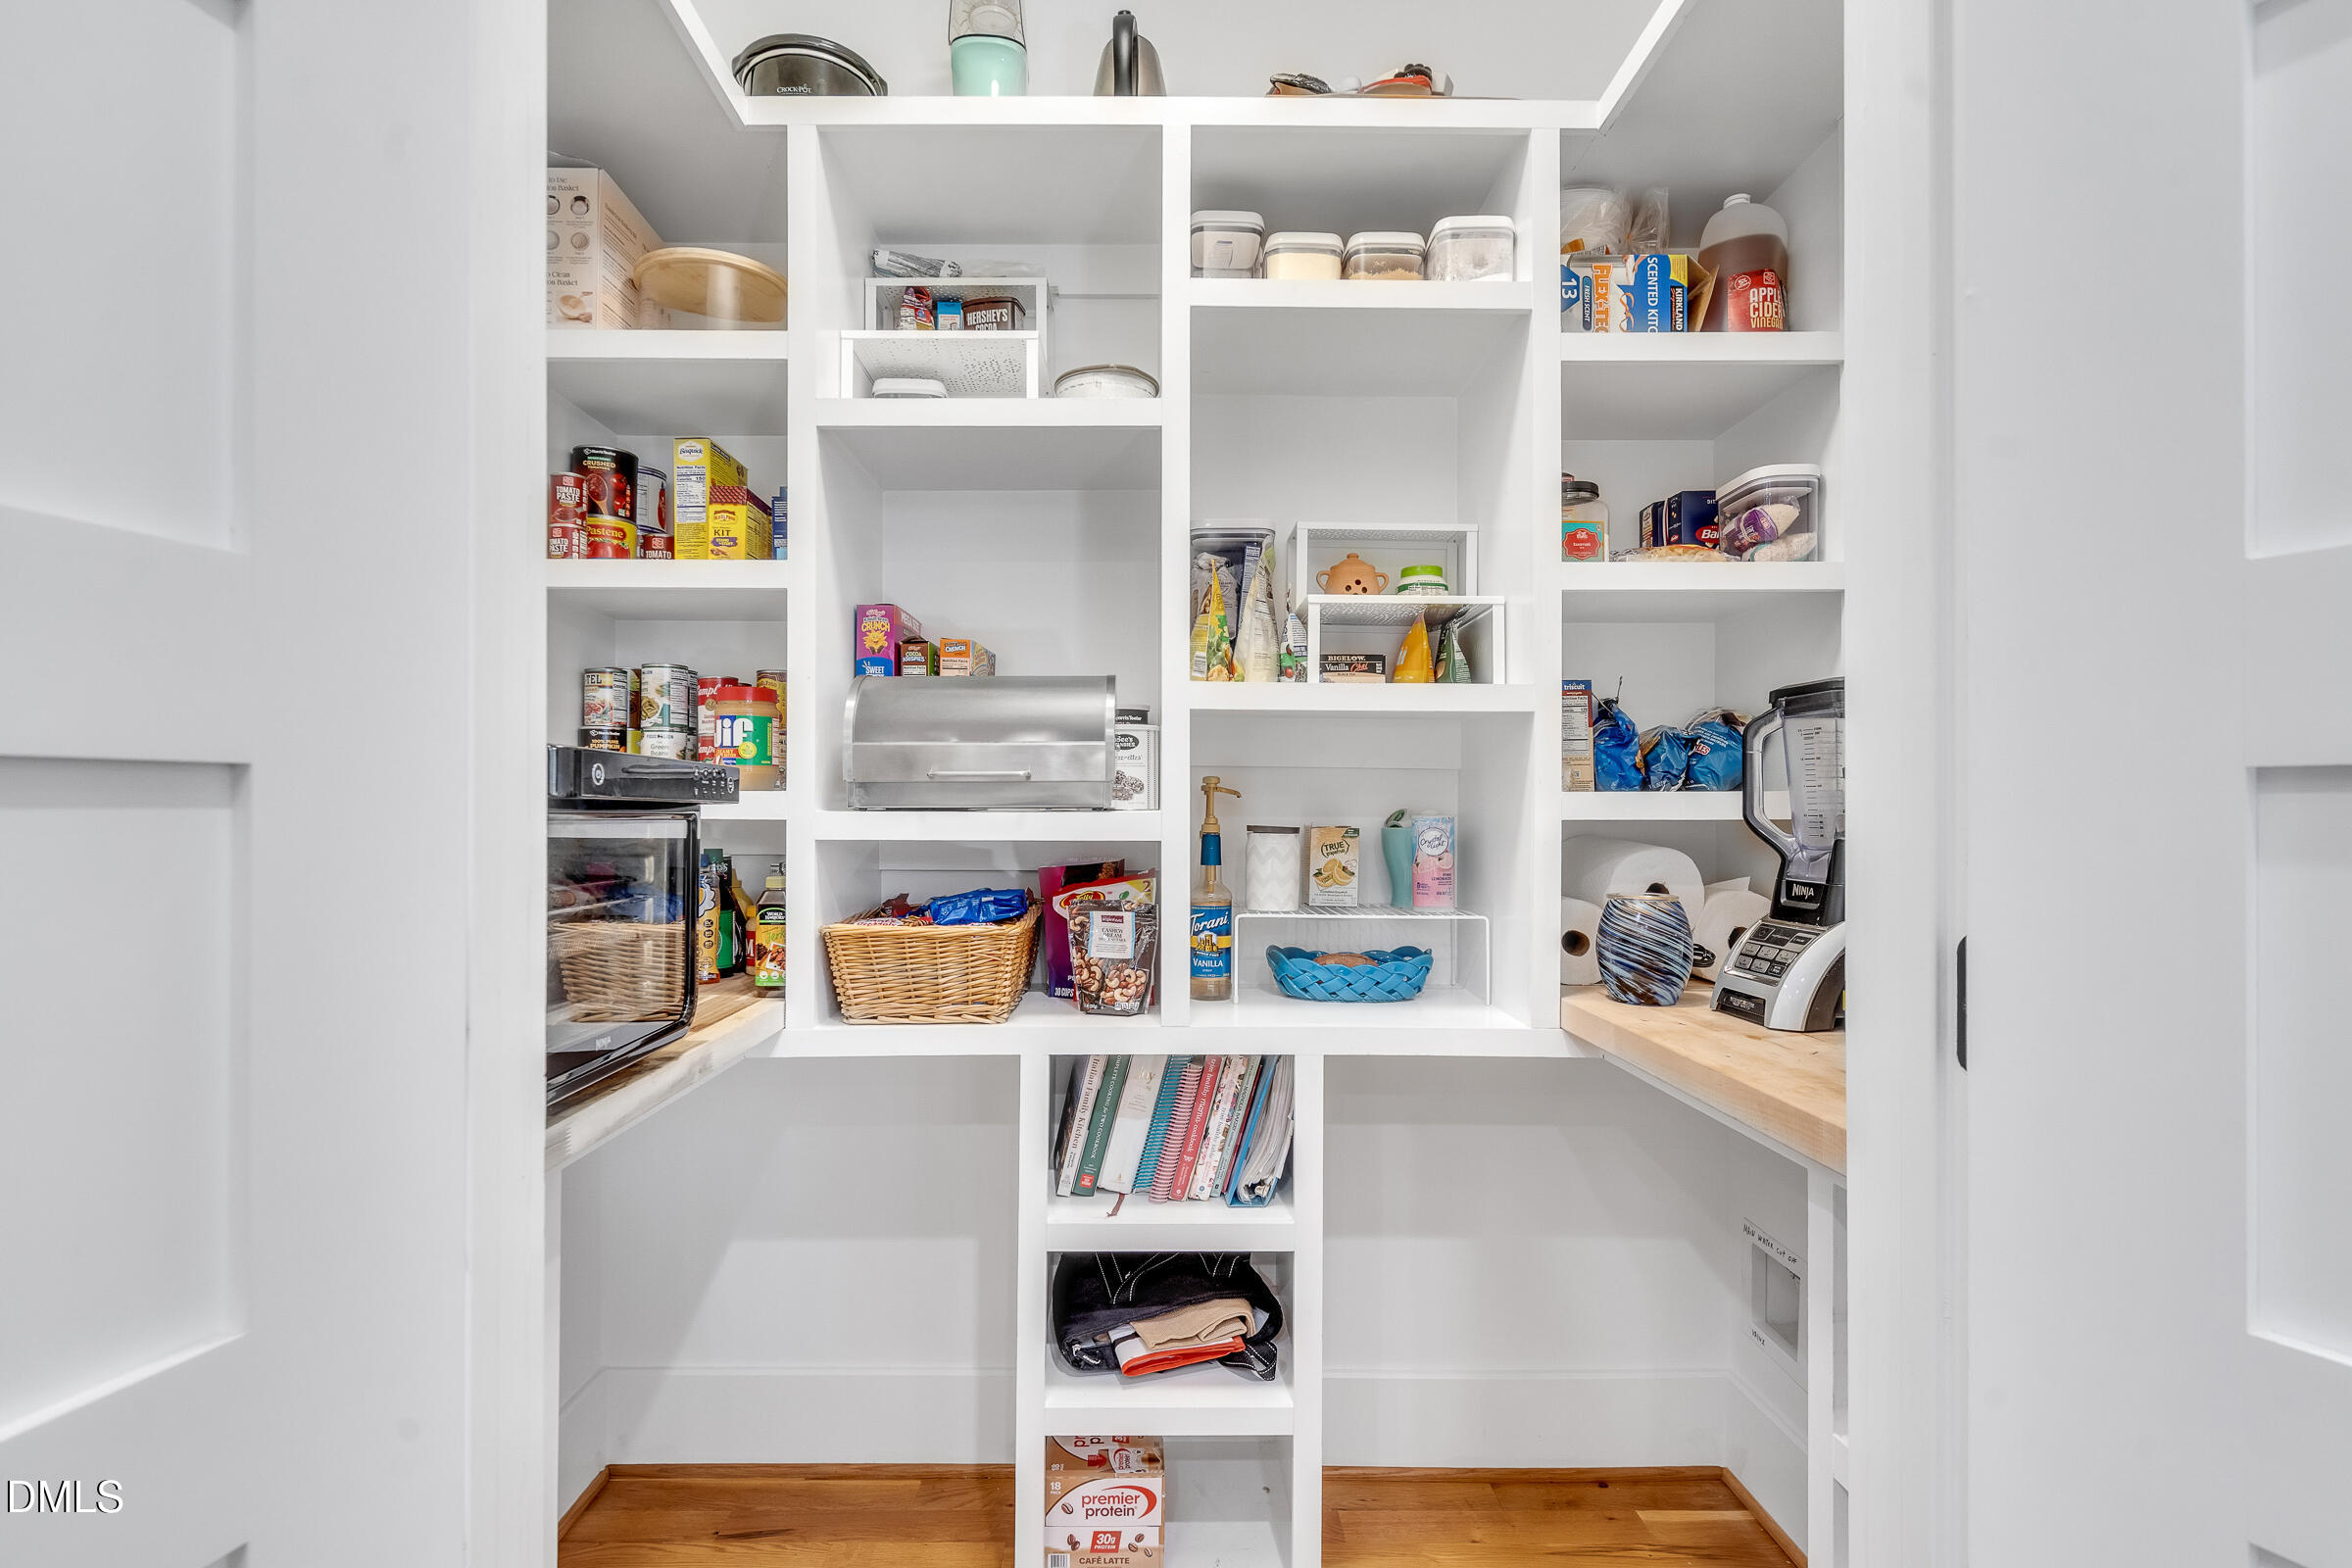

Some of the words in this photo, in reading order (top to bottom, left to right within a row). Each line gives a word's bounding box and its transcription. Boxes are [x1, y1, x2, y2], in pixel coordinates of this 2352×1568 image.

[1562, 278, 1578, 299] 13
[1647, 257, 1658, 307] SCENTED
[1592, 263, 1612, 332] FLEX-TEC
[1675, 287, 1684, 331] KIRKLAND
[966, 309, 1008, 325] HERSHEY'S
[1647, 310, 1658, 332] KITC
[582, 460, 616, 468] CRUSHED
[556, 486, 580, 497] TOMATO
[556, 493, 580, 503] PASTE
[587, 526, 624, 538] Pastene
[645, 550, 672, 560] TOMATO
[860, 621, 891, 633] CRUNCH
[865, 665, 885, 674] SWEET
[1325, 662, 1349, 671] Vanilla
[1349, 662, 1369, 673] Chai
[586, 674, 602, 684] TEL
[1696, 743, 1710, 756] LES
[1324, 841, 1345, 852] TRUE
[1142, 880, 1152, 893] 2
[1791, 883, 1814, 900] NINJA
[1190, 910, 1229, 936] Torani
[1193, 957, 1223, 967] VANILLA
[1111, 1054, 1122, 1081] OMPLETE
[1201, 1073, 1214, 1097] healthy
[1104, 1081, 1115, 1107] COOKING
[1071, 1116, 1086, 1150] Kitchen
[1187, 1124, 1200, 1152] cookbook
[1091, 1127, 1103, 1159] COOKBOOK
[1051, 1481, 1061, 1491] 18
[1082, 1492, 1140, 1508] premier
[1085, 1504, 1135, 1520] protein
[1096, 1533, 1116, 1544] 30g
[1079, 1555, 1102, 1565] CAFÉ
